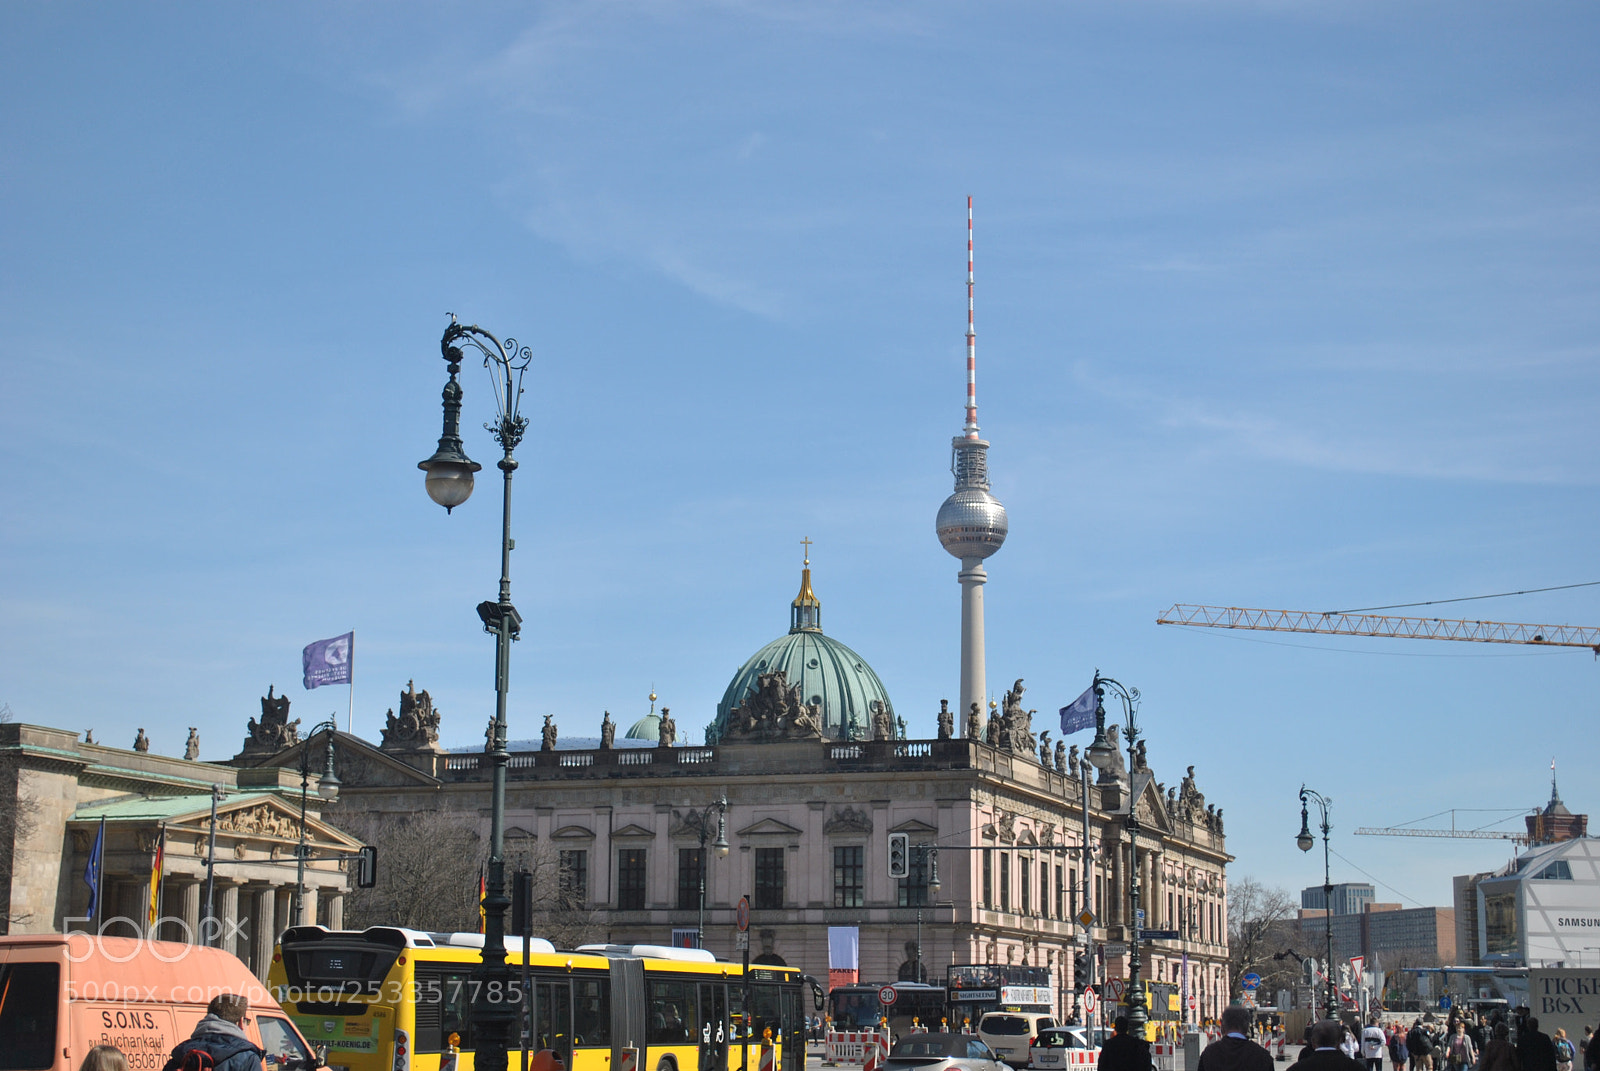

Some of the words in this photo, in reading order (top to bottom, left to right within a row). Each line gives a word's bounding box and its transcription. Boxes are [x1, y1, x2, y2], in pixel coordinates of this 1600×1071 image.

[882, 990, 893, 1000] 30
[1541, 996, 1584, 1014] BOX
[102, 1011, 158, 1030] S.O.N.S.
[101, 1032, 164, 1049] Buchankauf
[124, 1053, 172, 1069] 950870
